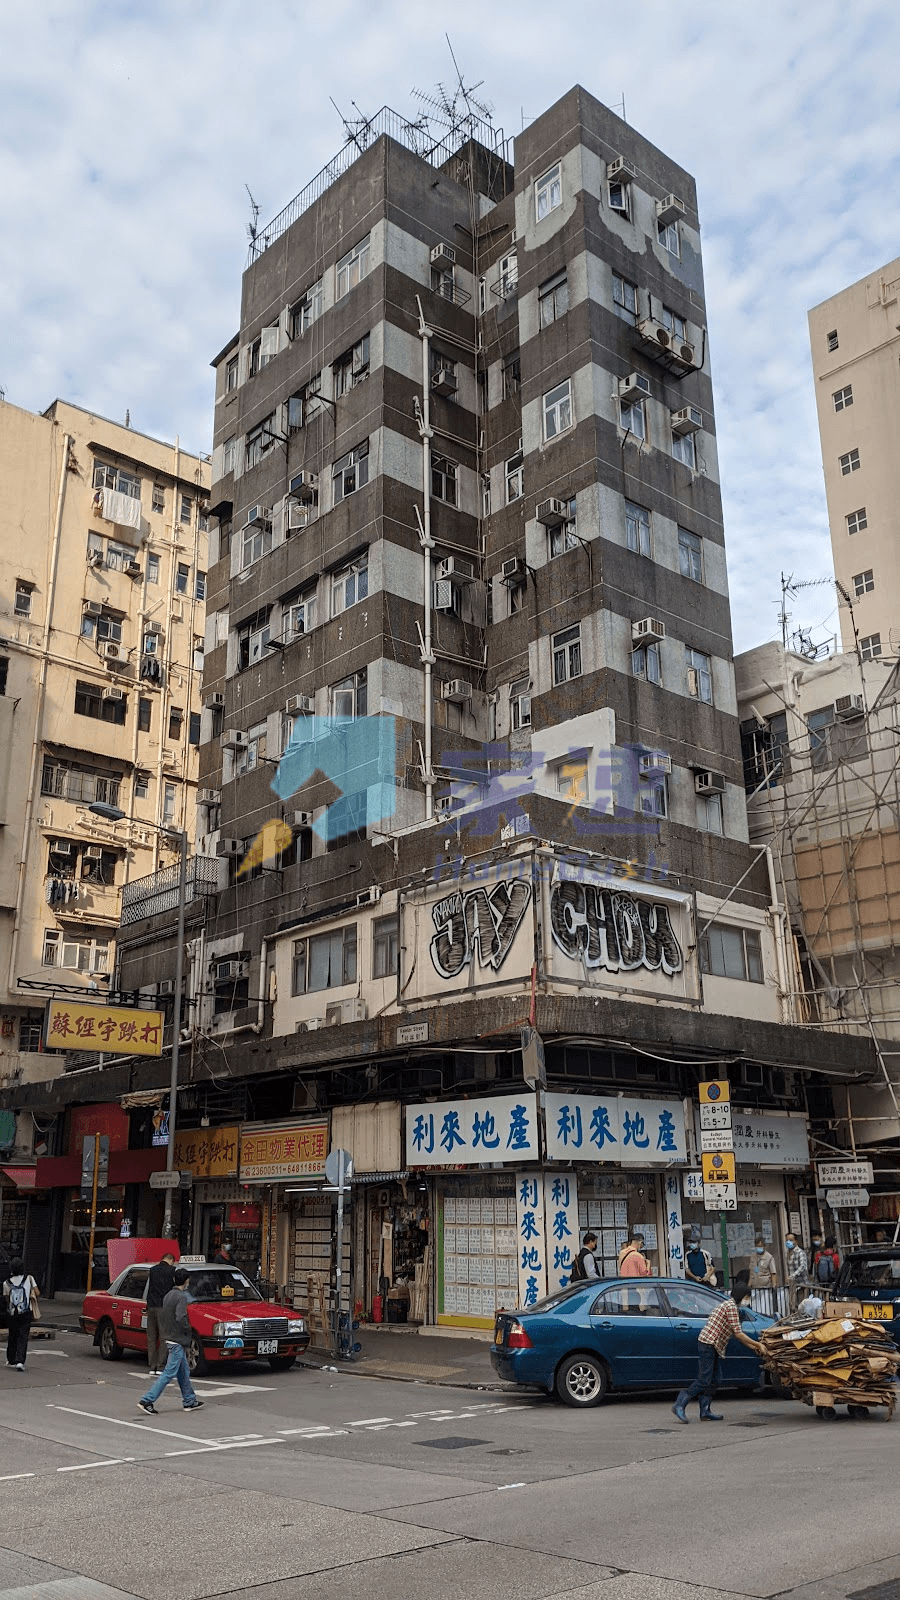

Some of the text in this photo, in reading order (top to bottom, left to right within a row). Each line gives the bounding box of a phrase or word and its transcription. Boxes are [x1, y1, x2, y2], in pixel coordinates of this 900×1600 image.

[430, 878, 532, 979] JAY
[50, 1011, 161, 1045] 蘇經宇跌打
[711, 1106, 729, 1114] 8-10
[712, 1118, 727, 1126] 5-7
[412, 1104, 531, 1154] 利來地產
[556, 1104, 679, 1152] 利來地產
[243, 1133, 325, 1163] 金田物業代理
[722, 1184, 729, 1194] 7
[724, 1200, 735, 1209] 12
[519, 1178, 542, 1307] 利來地產
